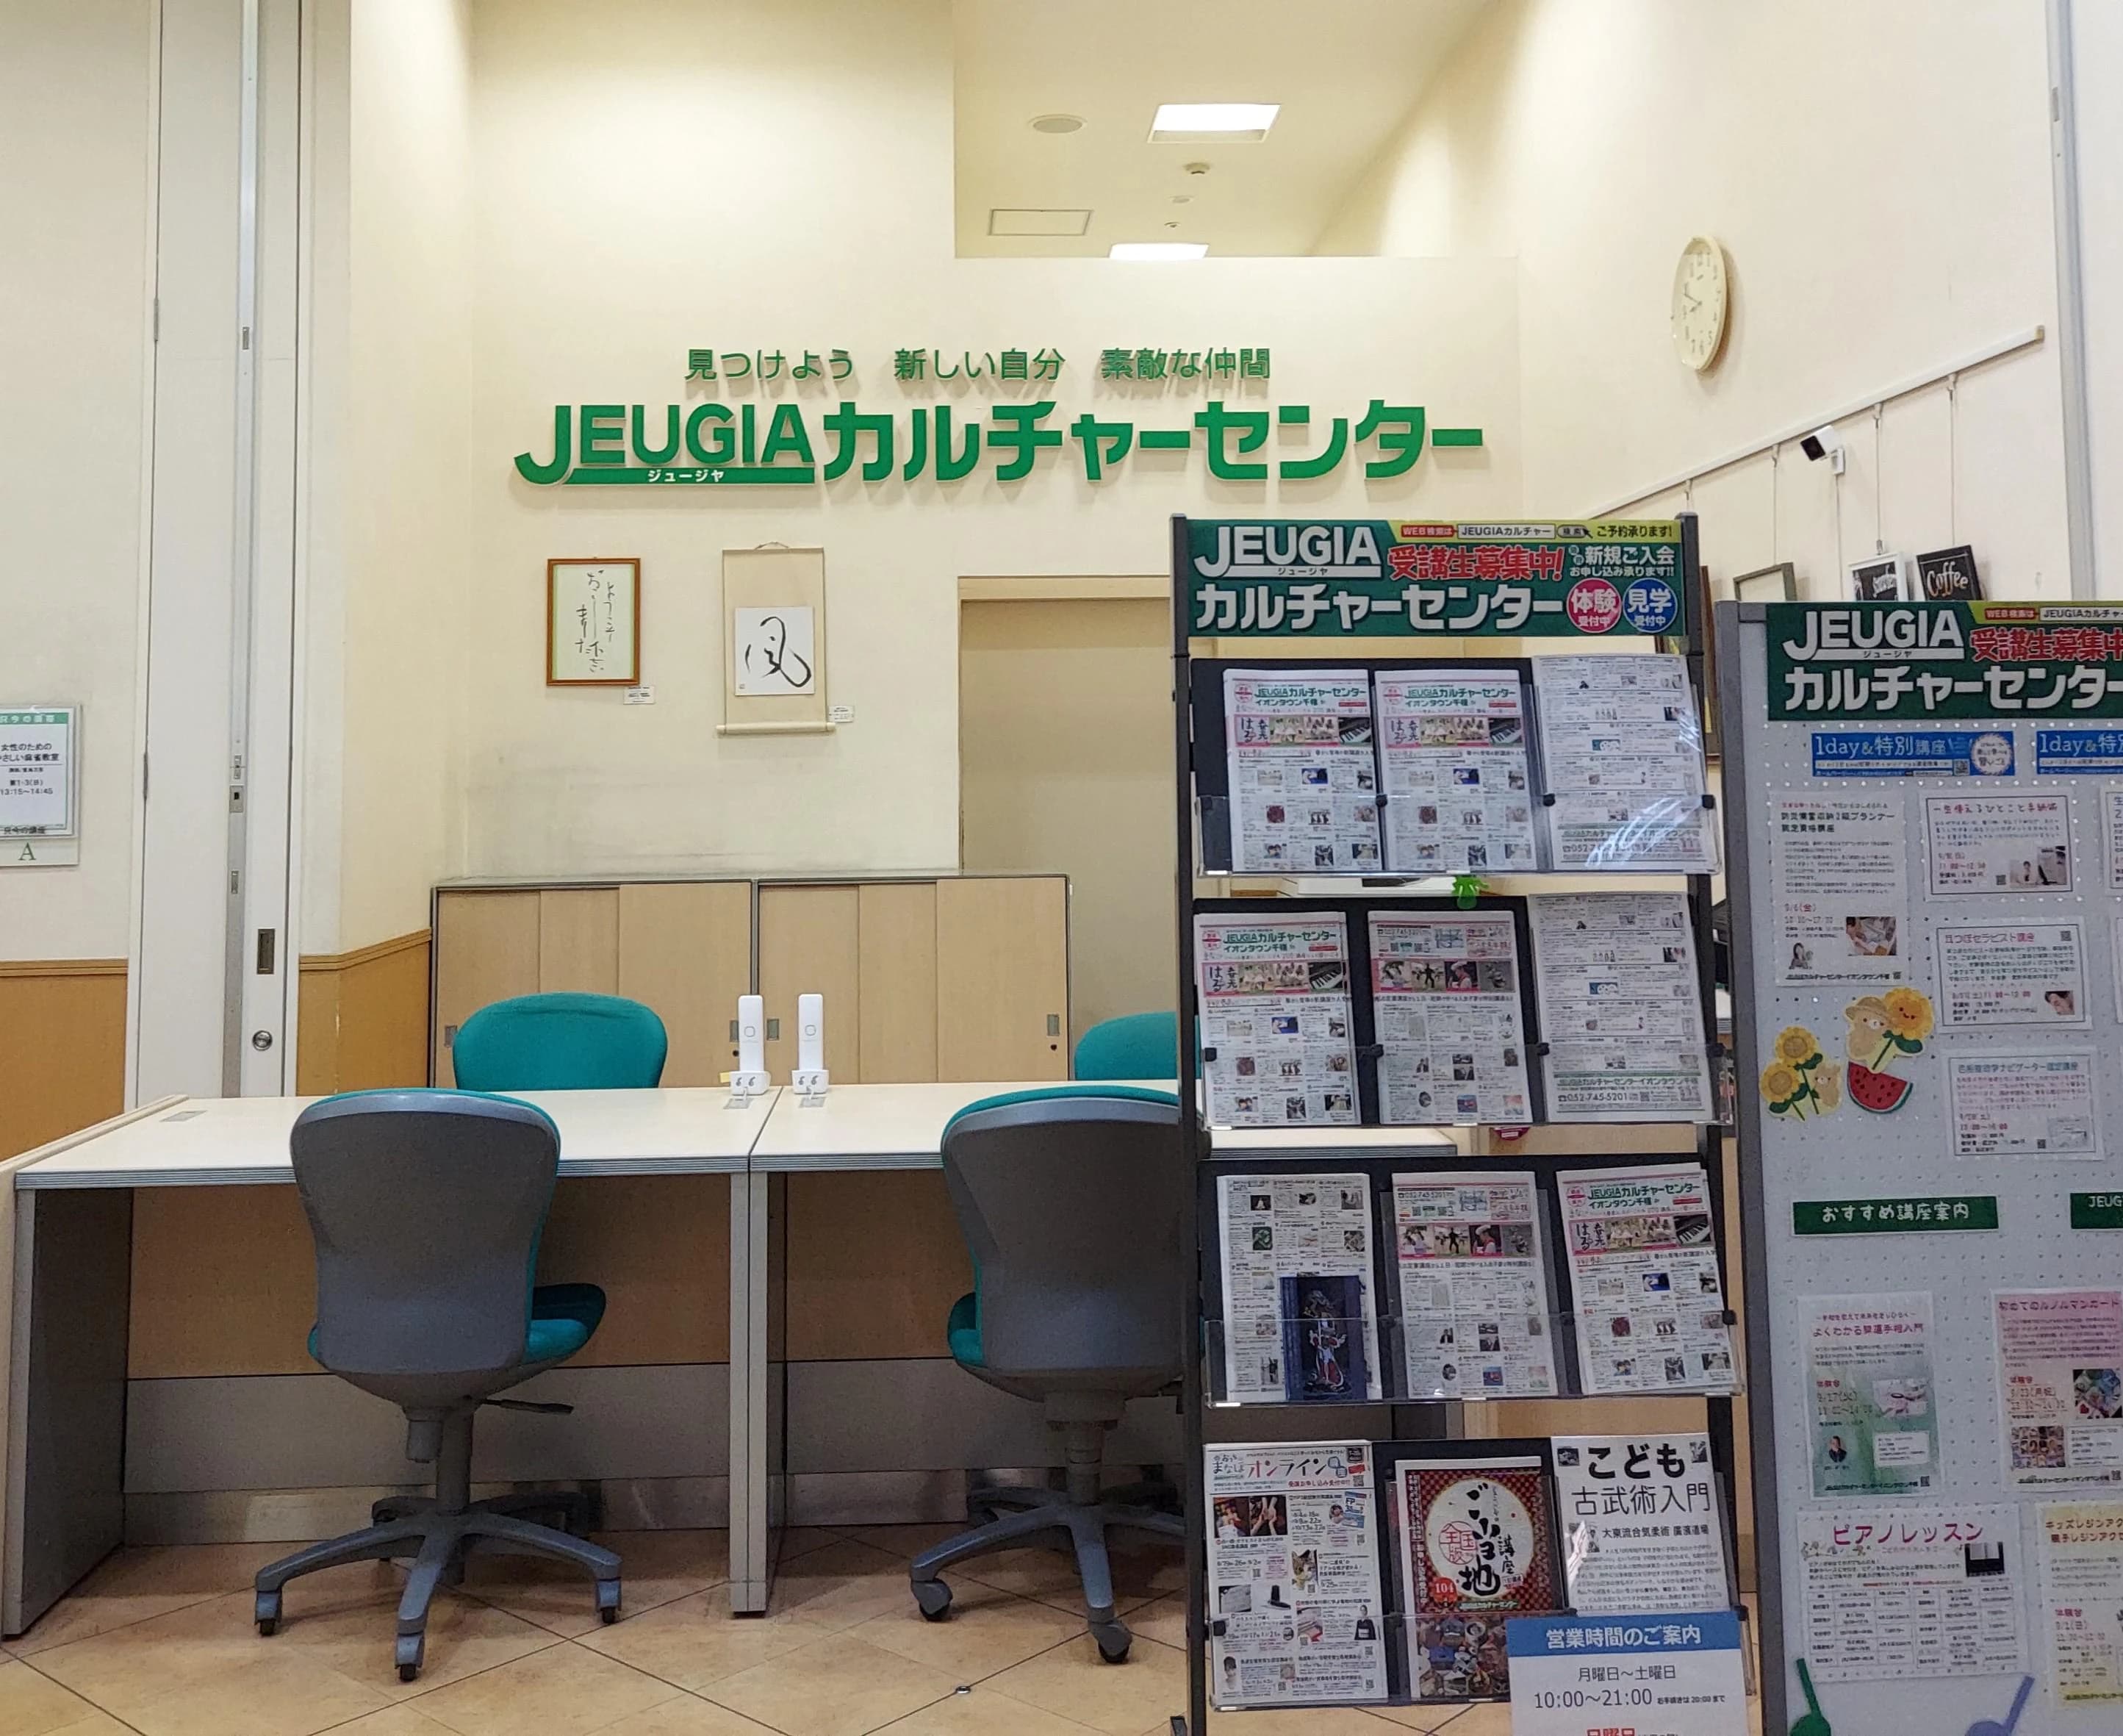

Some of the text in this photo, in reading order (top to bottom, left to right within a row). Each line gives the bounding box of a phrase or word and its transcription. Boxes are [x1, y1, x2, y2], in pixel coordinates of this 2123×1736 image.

[684, 347, 1271, 381] 見つけよう 新しい自分 素敵な仲間
[1462, 527, 1551, 537] JEUGIAカルチャー
[1194, 526, 1379, 576] JEUGIA
[1585, 545, 1675, 565] 新規ご入会
[1927, 562, 1969, 597] Coffee
[1198, 584, 1563, 631] カルチャーセンター
[1572, 589, 1617, 614] 体験
[1628, 589, 1673, 614] 見学
[1578, 616, 1611, 628] 受付中
[1783, 610, 1964, 660] JEUGIA
[1785, 664, 2123, 711] カルチャーセンター
[0, 753, 60, 761] さしい麻雀教室
[1, 742, 52, 751] 女性のための
[18, 842, 37, 861] A
[1822, 1202, 1969, 1223] おすすめ講座案内
[1246, 1458, 1327, 1478] オンライン
[1588, 1443, 1685, 1479] こども
[1571, 1482, 1710, 1516] 古武術入門
[1602, 1528, 1670, 1539] 大東流合気柔術
[1833, 1523, 1983, 1545] ピアノレッスン
[1435, 1583, 1454, 1593] 104
[1546, 1625, 1702, 1649] 営業時間のご案内
